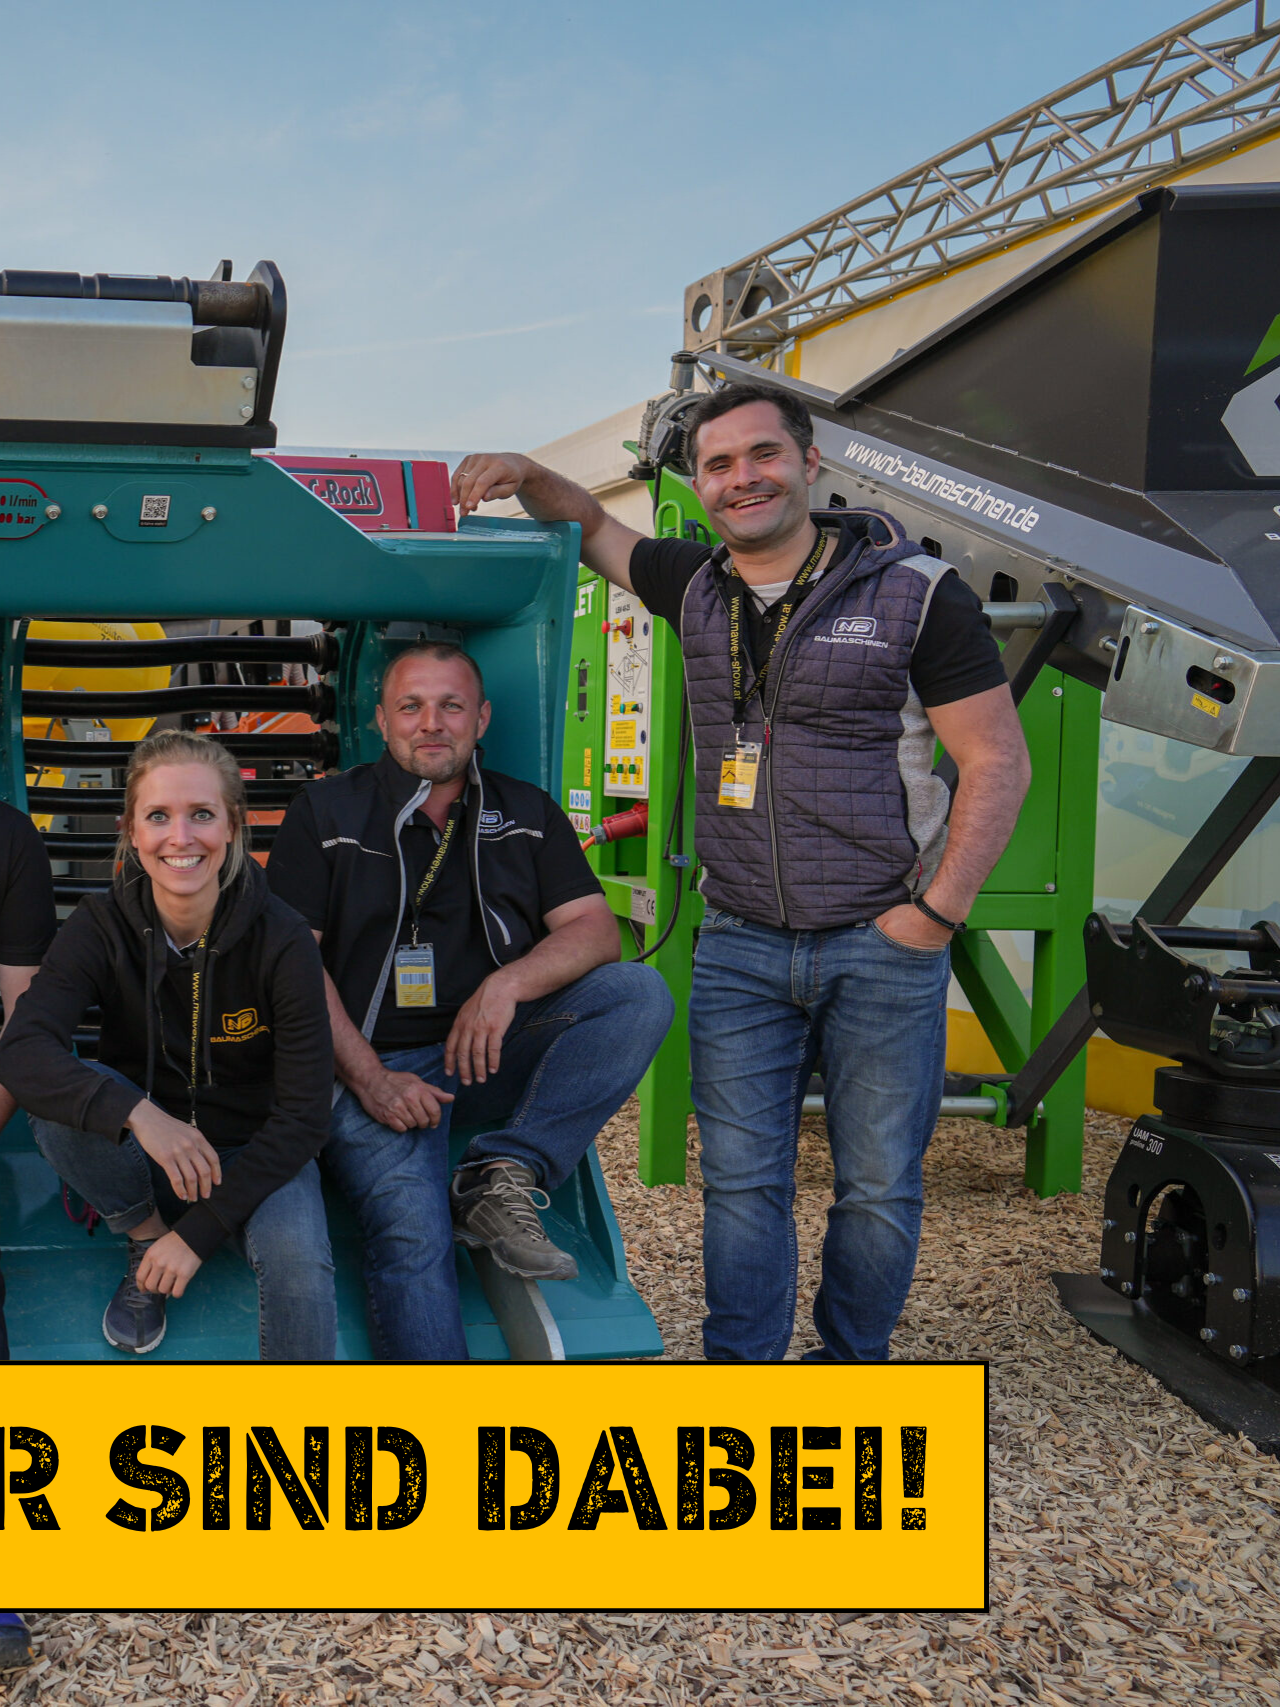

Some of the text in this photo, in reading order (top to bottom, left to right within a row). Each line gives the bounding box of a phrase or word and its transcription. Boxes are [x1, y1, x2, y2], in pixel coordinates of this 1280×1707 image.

[844, 440, 1040, 533] www.nb-baumaschinen.de
[9, 494, 38, 507] l/min
[17, 513, 36, 525] bar
[730, 596, 742, 700] www.mawev-show.at
[814, 635, 889, 648] BAUMASCHINEN
[1133, 1127, 1163, 1155] UAM 300
